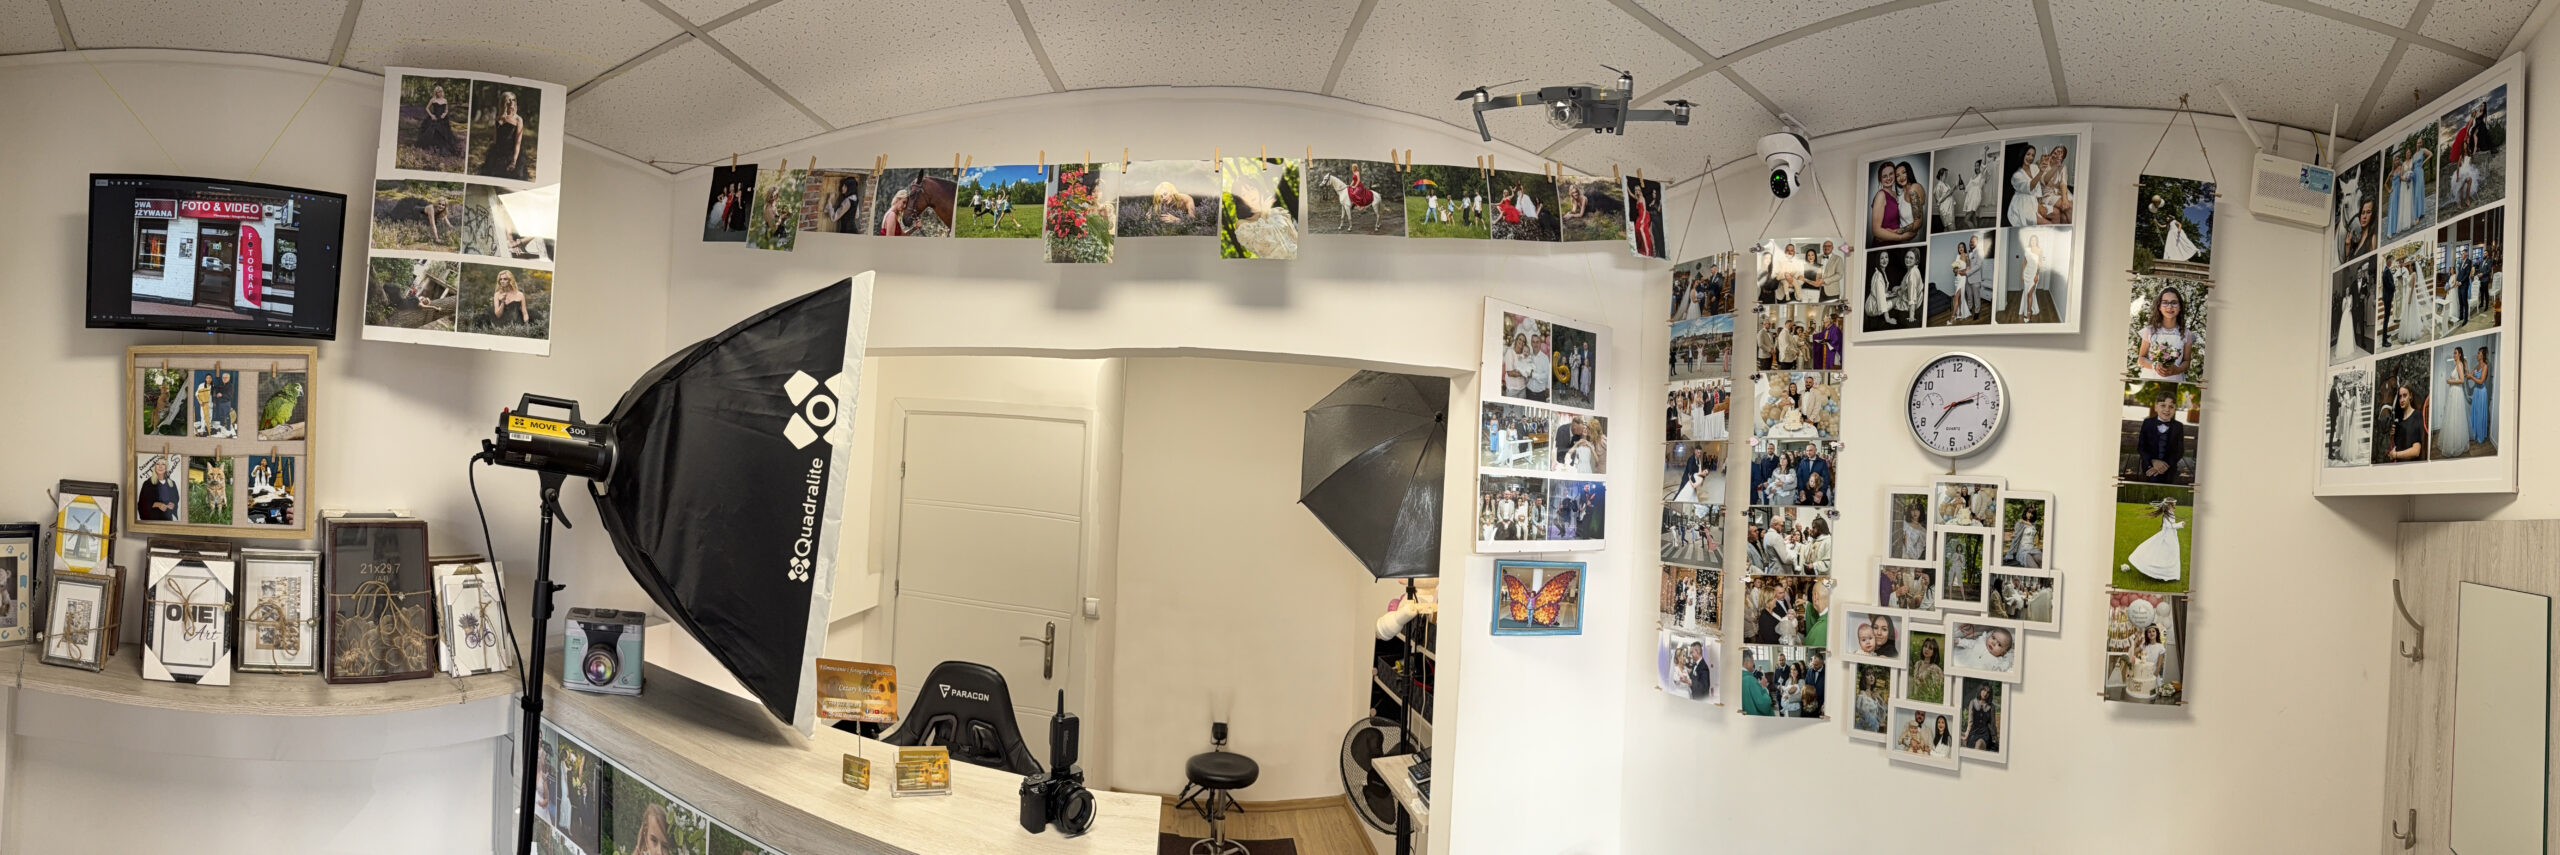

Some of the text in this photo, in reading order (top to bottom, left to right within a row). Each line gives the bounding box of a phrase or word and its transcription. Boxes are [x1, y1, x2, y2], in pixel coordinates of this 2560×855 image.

[181, 201, 260, 214] FOTO & VIDEO
[1937, 369, 1978, 378] 11 1
[1953, 363, 1963, 373] 12
[1924, 381, 1991, 391] 10 2
[1916, 401, 1996, 410] 9 3
[1920, 417, 1988, 428] 8 4
[530, 421, 557, 431] MOVE
[569, 427, 586, 436] 300
[1933, 431, 1973, 441] 7 5
[1949, 437, 1955, 447] 6
[794, 457, 824, 557] Quadralite
[360, 562, 401, 574] 21x29.7
[166, 604, 214, 624] ONE
[184, 624, 222, 642] Art
[951, 688, 990, 702] PARACON
